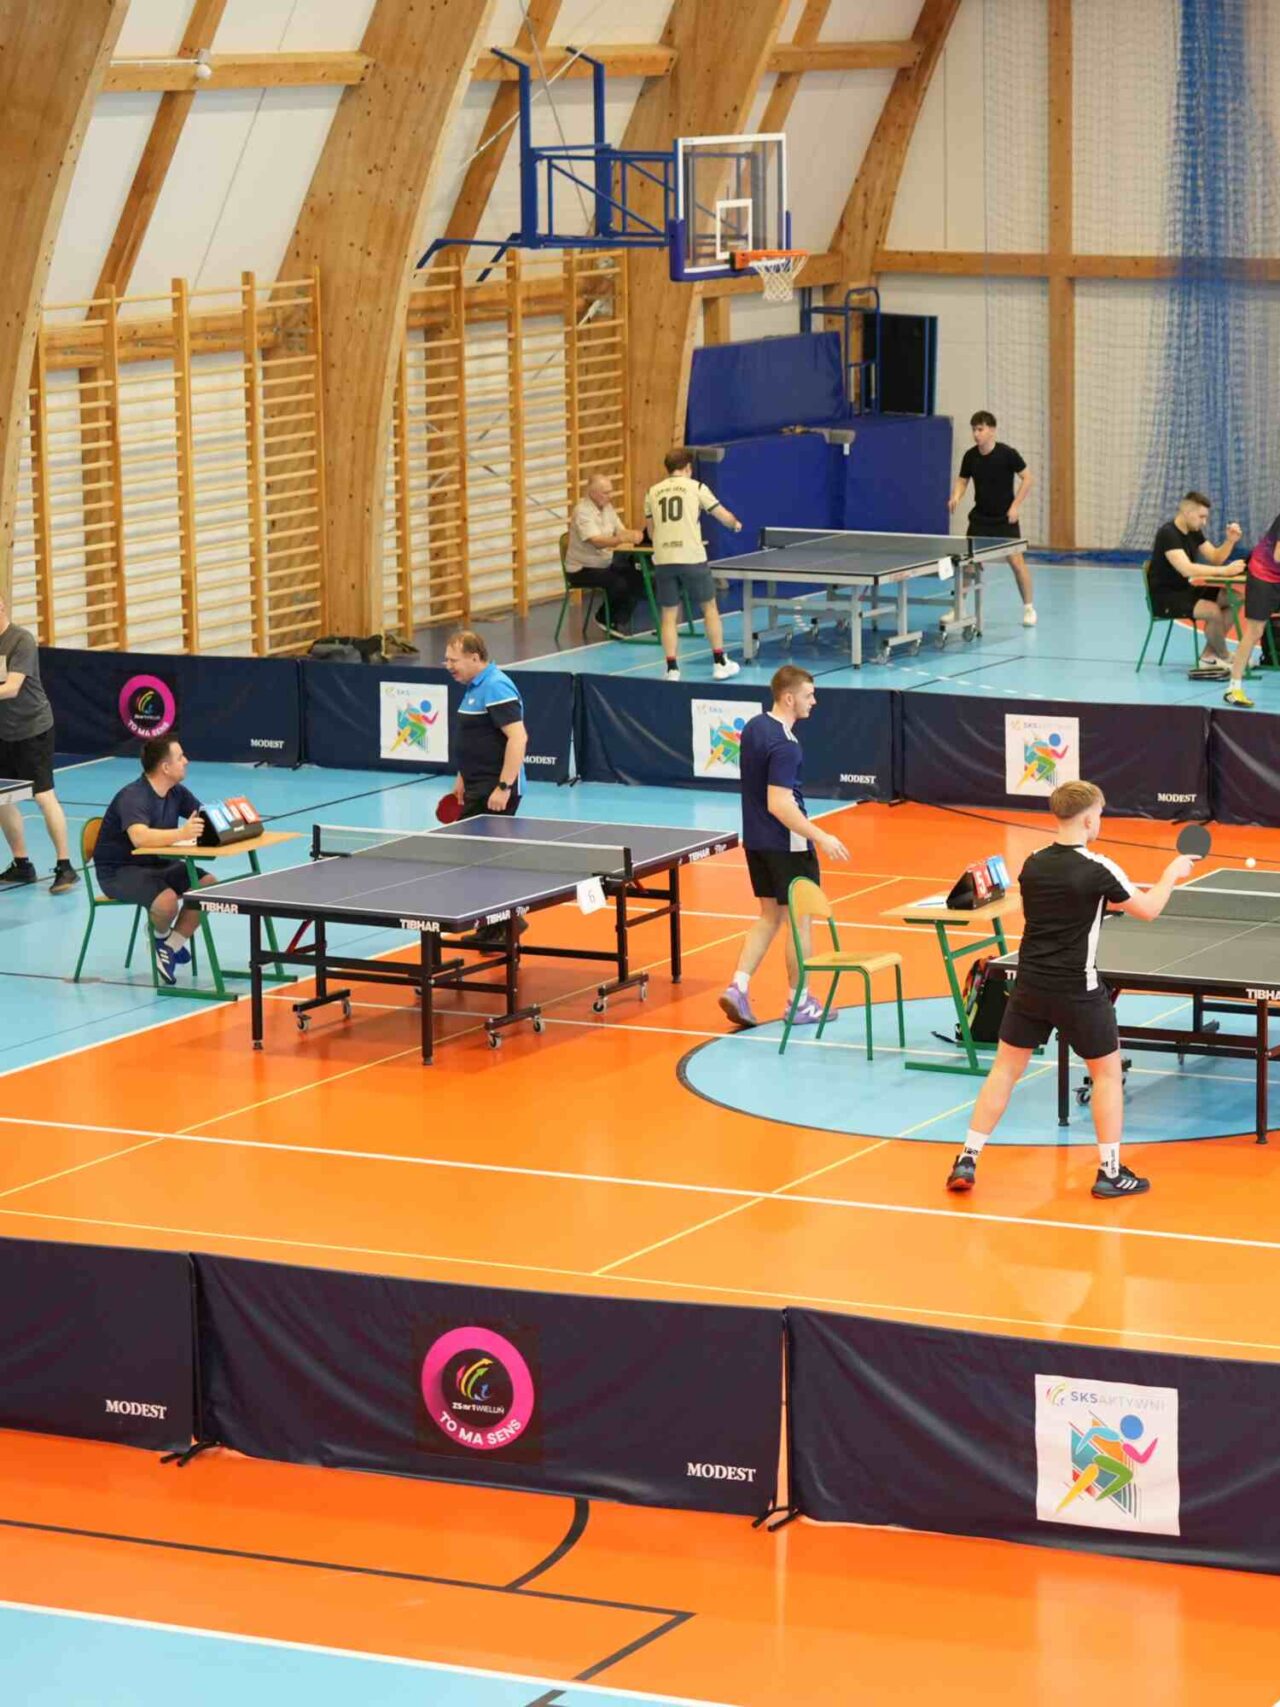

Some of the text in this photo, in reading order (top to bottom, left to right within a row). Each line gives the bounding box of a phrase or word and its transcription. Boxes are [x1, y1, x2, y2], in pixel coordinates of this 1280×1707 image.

[658, 495, 683, 523] 10
[250, 738, 285, 750] MODEST
[839, 773, 877, 784] MODEST
[1157, 792, 1197, 803] MODEST
[199, 901, 239, 914] TIBHAR
[485, 909, 511, 925] TIBHAR
[400, 918, 441, 932] TIBHAR
[105, 1399, 168, 1419] MODEST
[439, 1411, 522, 1445] TO MA SENS
[686, 1462, 757, 1482] MODEST
